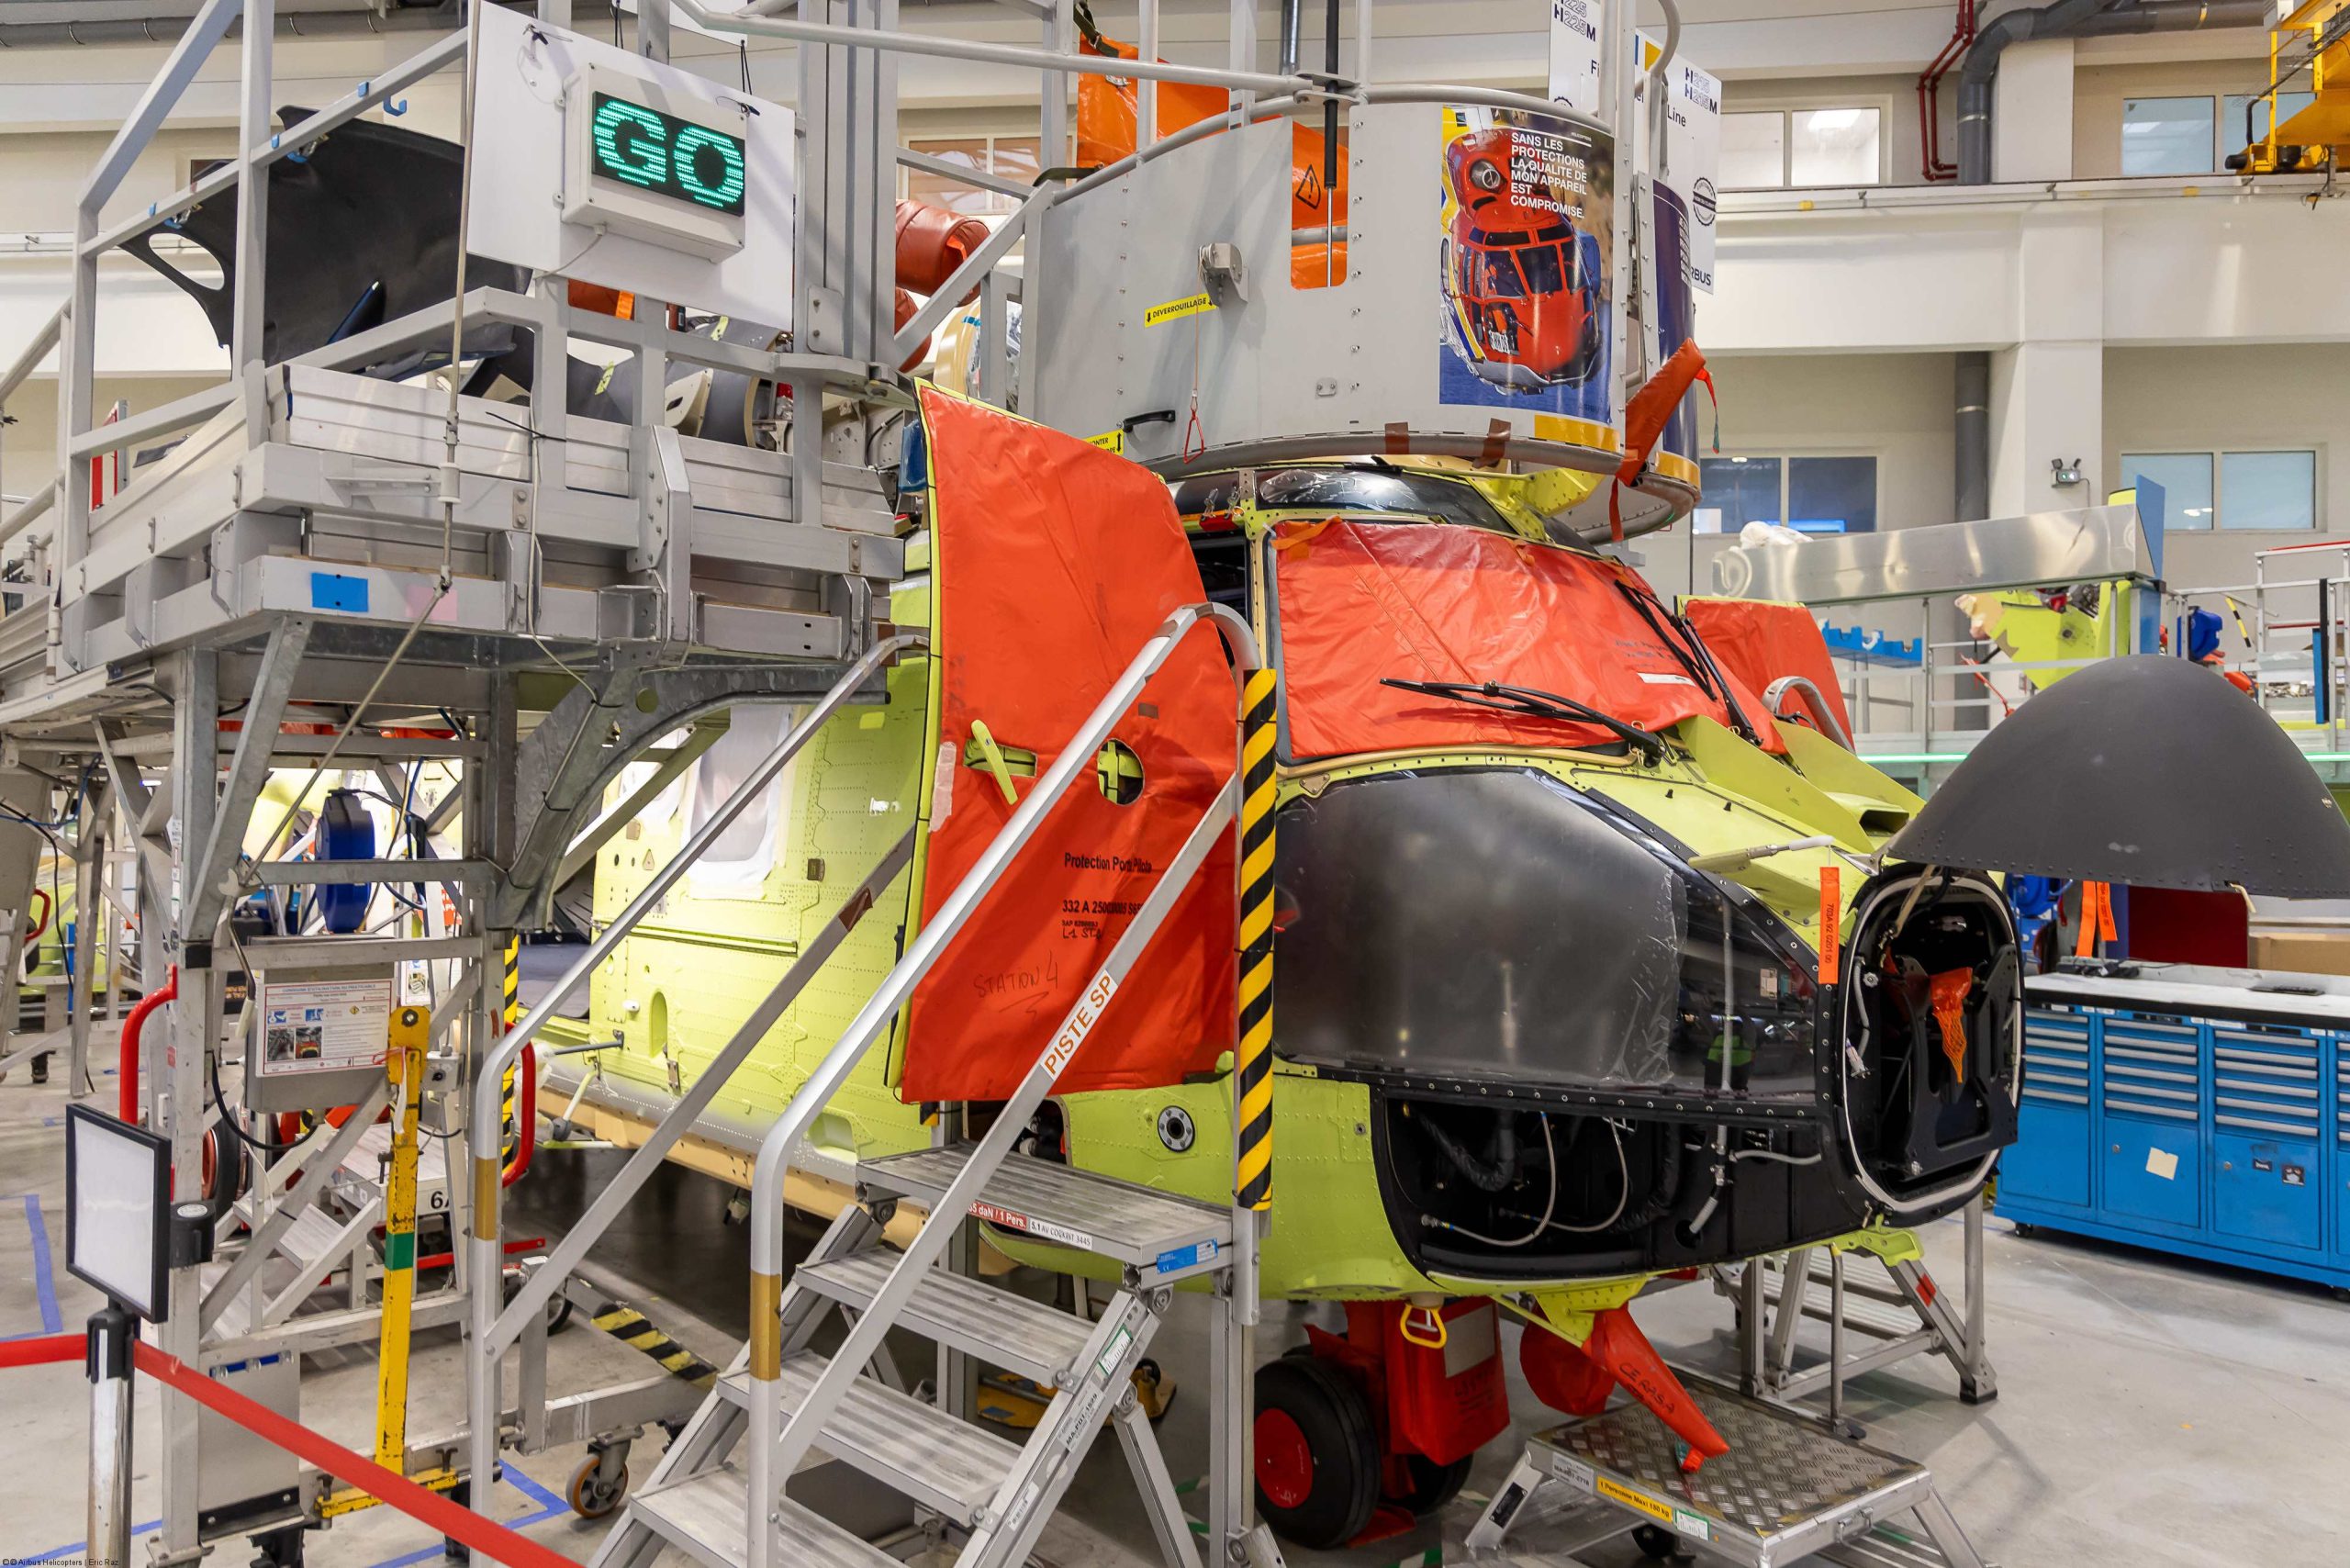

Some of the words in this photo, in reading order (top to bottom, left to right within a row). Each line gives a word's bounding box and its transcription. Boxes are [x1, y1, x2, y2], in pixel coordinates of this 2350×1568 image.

[1560, 0, 1587, 17] 225
[1554, 4, 1596, 42] H225M
[1667, 104, 1686, 127] Line
[1511, 132, 1541, 147] SANS
[1544, 138, 1563, 151] LES
[594, 100, 744, 207] GO
[1511, 144, 1584, 170] PROTECTIONS
[1511, 157, 1525, 169] LA
[1528, 160, 1572, 179] QUALITE
[1574, 172, 1587, 183] DE
[1511, 169, 1538, 184] MON
[1539, 174, 1587, 196] APPAREIL
[1511, 182, 1532, 196] EST
[1510, 195, 1584, 218] COMPROMISE.
[1152, 297, 1207, 319] DEVERROUILLAGE
[1064, 852, 1111, 871] Protection
[1062, 900, 1080, 913] 332
[1081, 901, 1090, 913] A
[973, 966, 1040, 999] STATION
[1046, 948, 1058, 989] 4
[1044, 1006, 1093, 1076] PISTE
[1090, 975, 1113, 1009] SP
[979, 1204, 993, 1218] daN
[1006, 1213, 1026, 1228] Pers.
[1605, 1482, 1633, 1501] Personne
